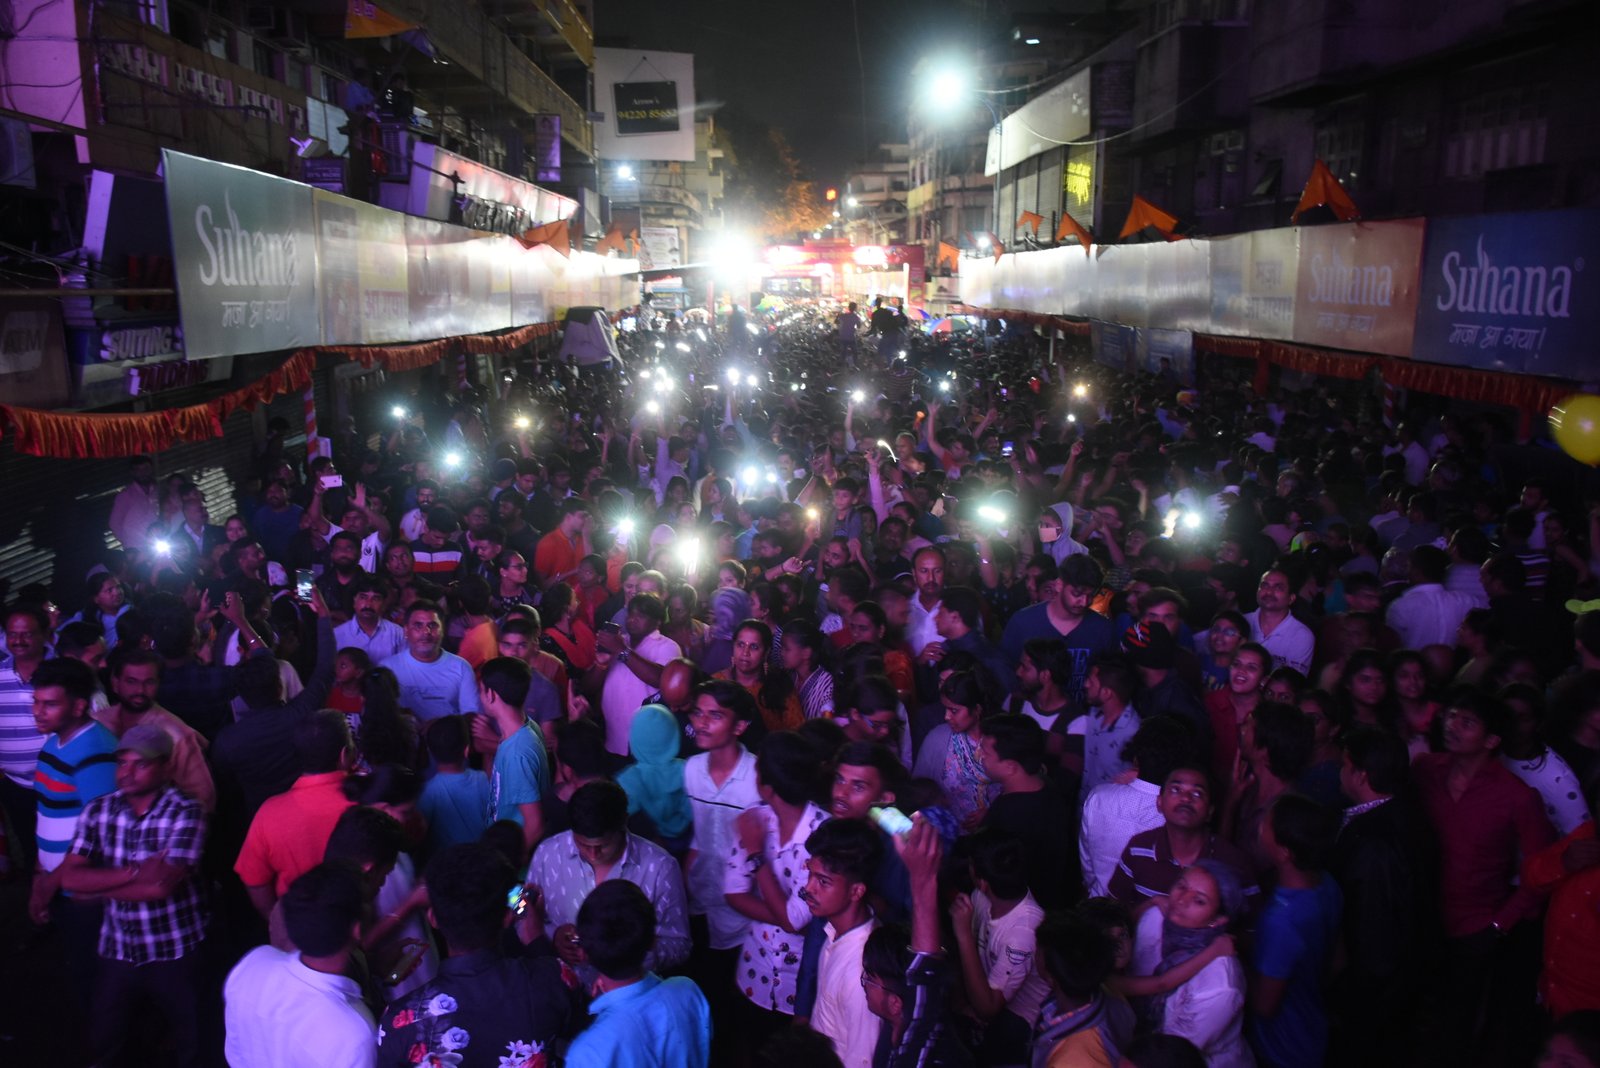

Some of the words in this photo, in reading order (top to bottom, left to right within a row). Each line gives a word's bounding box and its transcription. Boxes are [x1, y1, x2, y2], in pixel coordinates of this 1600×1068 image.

[195, 187, 300, 287] Suhana
[1308, 245, 1393, 307] Suhana
[1437, 233, 1572, 318] Suhana
[2, 329, 42, 354] ATM
[101, 326, 172, 361] SUITING
[130, 359, 209, 396] TAILORING
